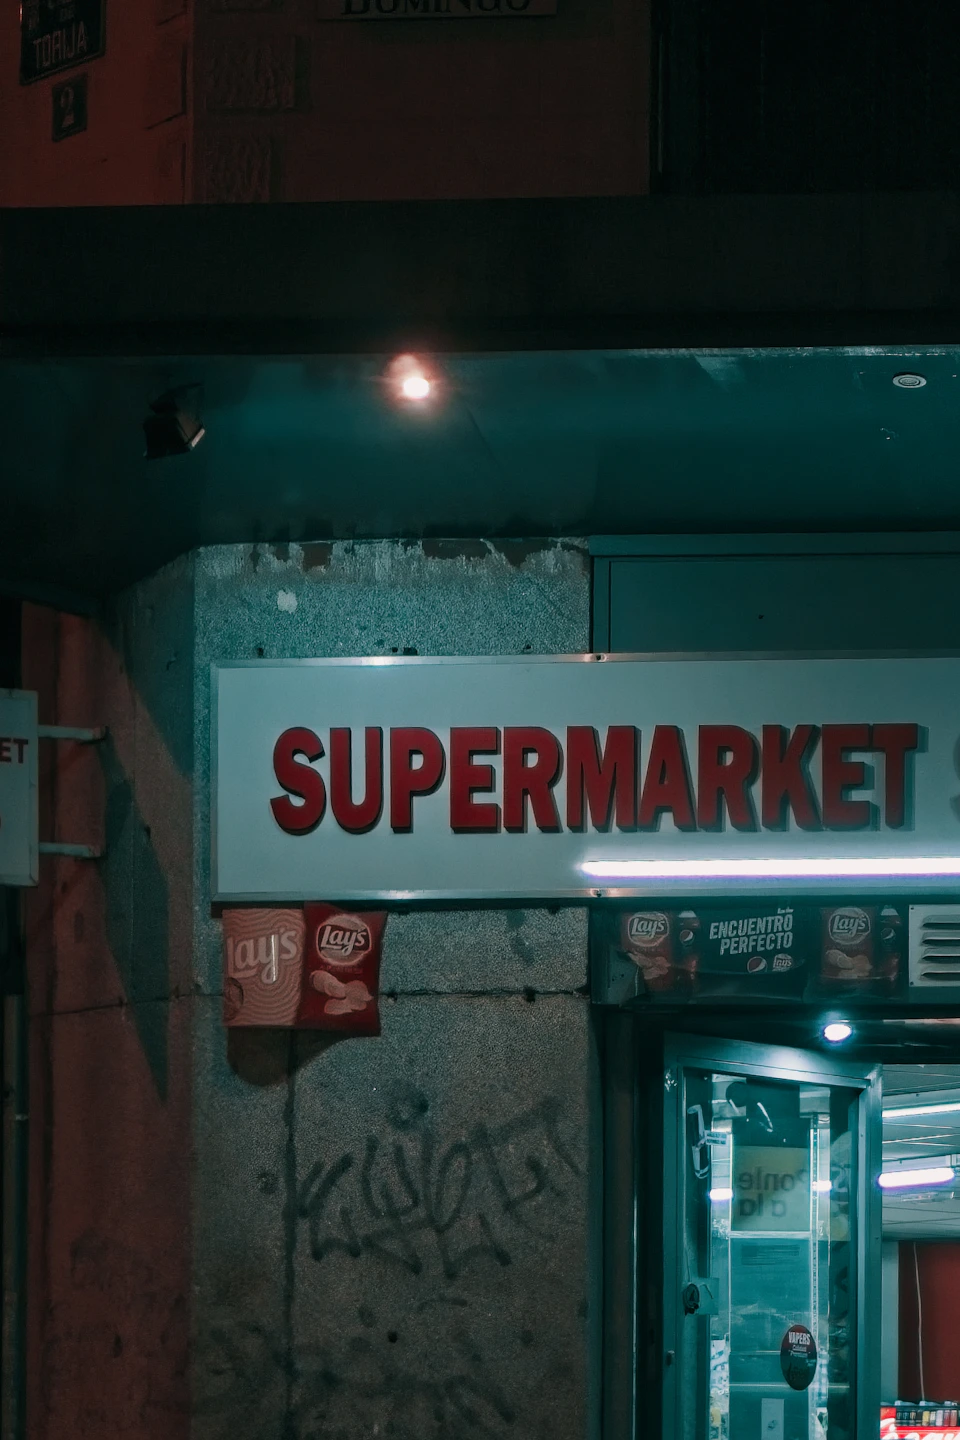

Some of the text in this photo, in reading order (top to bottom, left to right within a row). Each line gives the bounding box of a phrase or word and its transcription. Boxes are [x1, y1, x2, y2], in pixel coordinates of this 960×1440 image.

[61, 86, 75, 128] 2
[270, 722, 920, 836] SUPERMARKET
[320, 925, 368, 955] Lay's
[709, 913, 794, 940] ENCUENTRO
[720, 931, 794, 956] PERFECTO
[788, 1331, 811, 1346] VAPERS
